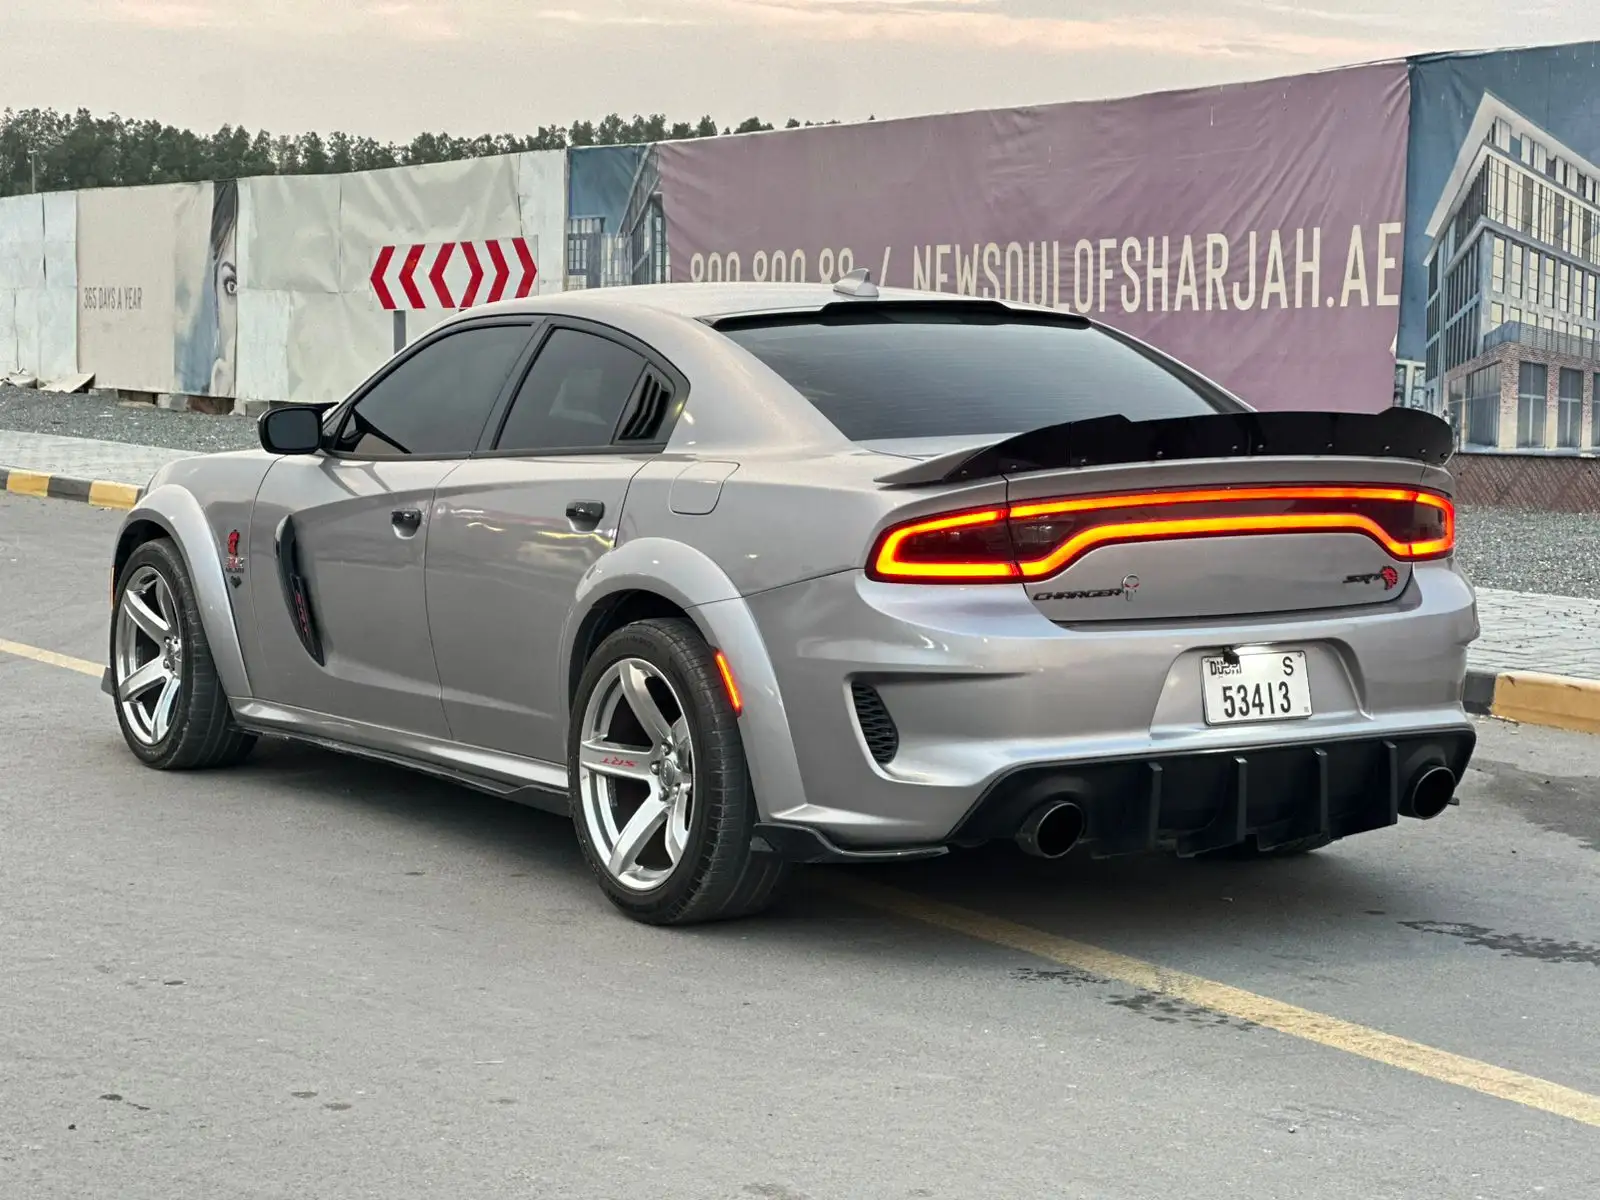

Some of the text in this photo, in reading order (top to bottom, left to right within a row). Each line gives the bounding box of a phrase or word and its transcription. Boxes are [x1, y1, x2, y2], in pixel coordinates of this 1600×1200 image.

[912, 222, 1402, 314] NEWSOULOFSHARJAH.AE
[84, 287, 143, 309] 365 DAYS A YEAR
[1032, 588, 1123, 601] CHARGER
[1282, 656, 1295, 676] S
[1222, 680, 1292, 718] 53413
